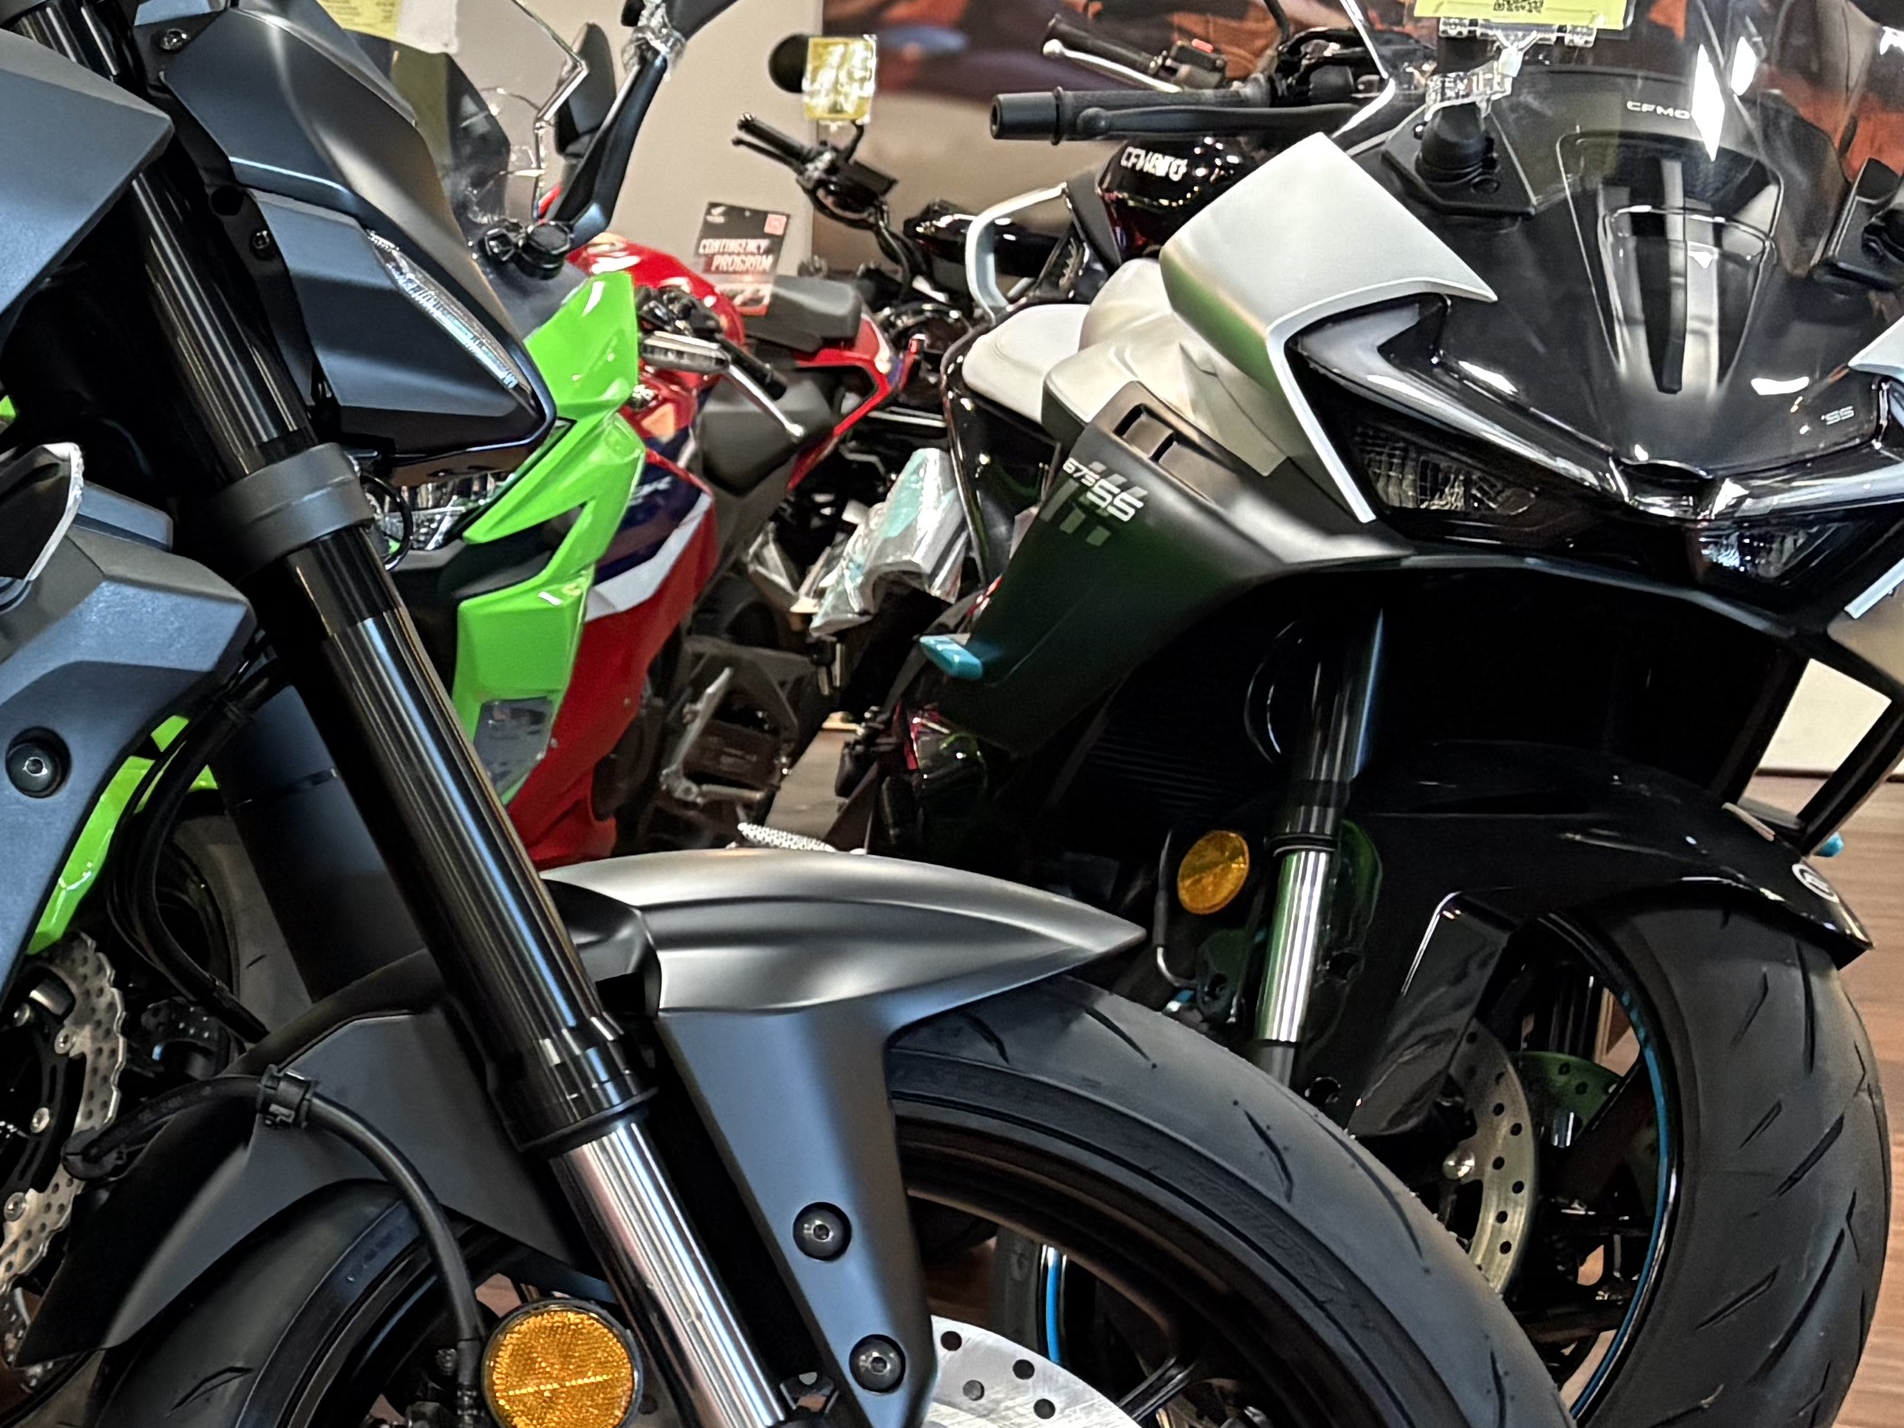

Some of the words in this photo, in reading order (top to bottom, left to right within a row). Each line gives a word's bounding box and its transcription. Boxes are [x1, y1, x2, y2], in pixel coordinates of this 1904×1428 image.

[1626, 100, 1692, 120] CFMO
[698, 238, 770, 254] CONTINGENCY
[711, 254, 773, 272] PROGRAM
